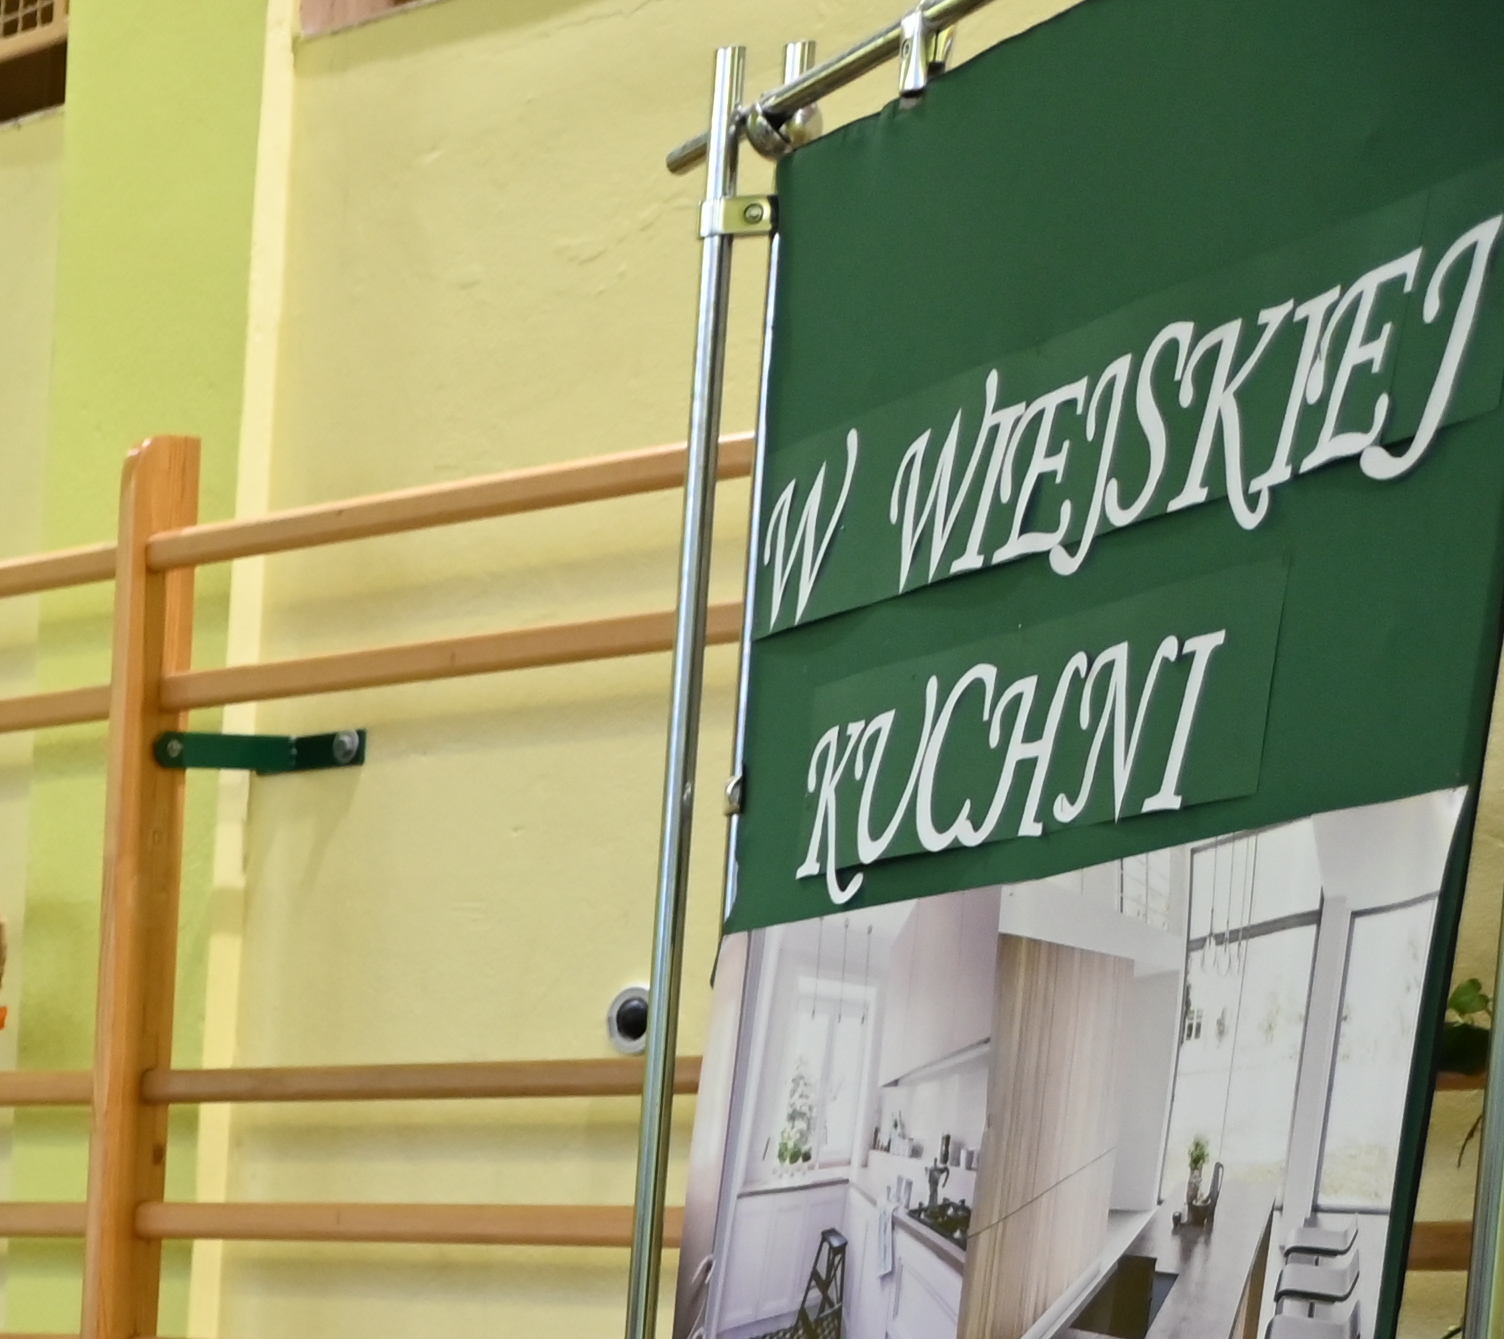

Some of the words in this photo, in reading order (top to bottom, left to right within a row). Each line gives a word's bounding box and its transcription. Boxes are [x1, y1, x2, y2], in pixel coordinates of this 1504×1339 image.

[763, 428, 859, 633] W
[890, 214, 1503, 595] WIEJSKIEJ
[795, 629, 1226, 906] KUCHNI
